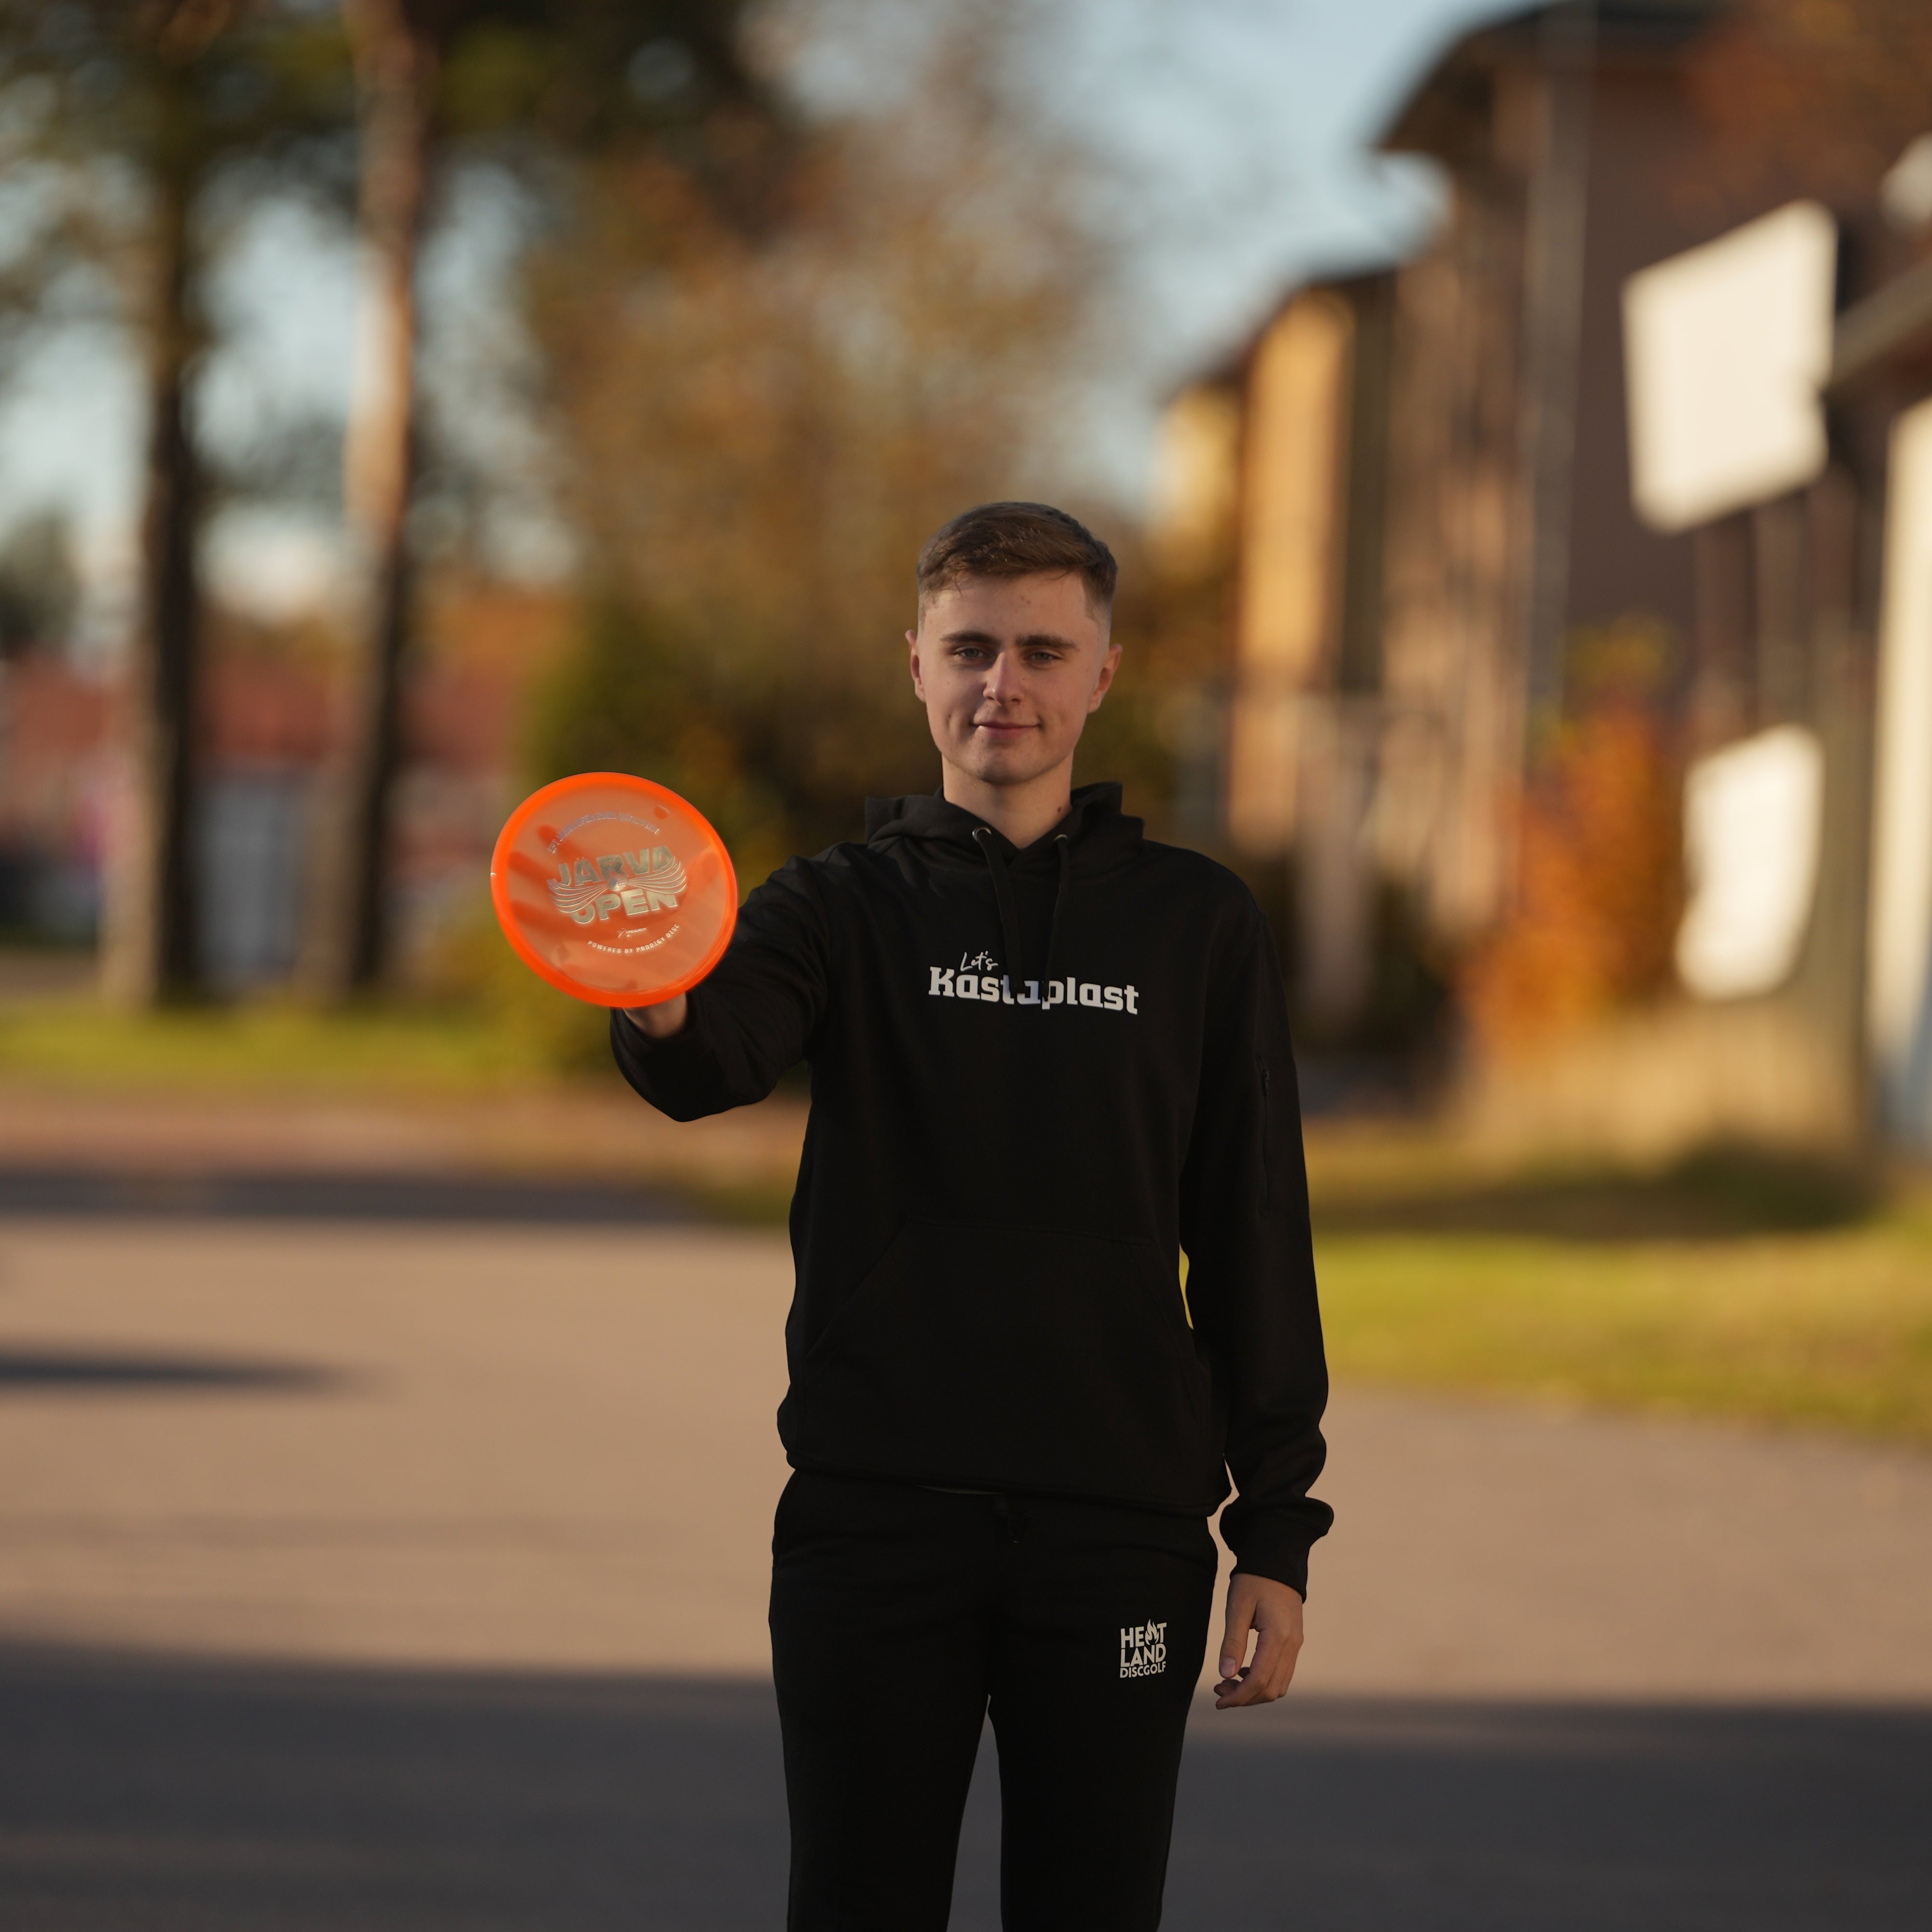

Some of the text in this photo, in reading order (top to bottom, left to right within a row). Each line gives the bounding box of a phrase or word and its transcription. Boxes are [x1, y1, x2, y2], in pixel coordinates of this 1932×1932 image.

[587, 940, 622, 953] POWERED
[636, 938, 665, 952] PRODIGY
[665, 923, 680, 938] DISC
[960, 950, 999, 972] Let's
[1120, 1643, 1166, 1667] LAND
[1120, 1661, 1166, 1678] DISCGOLF
